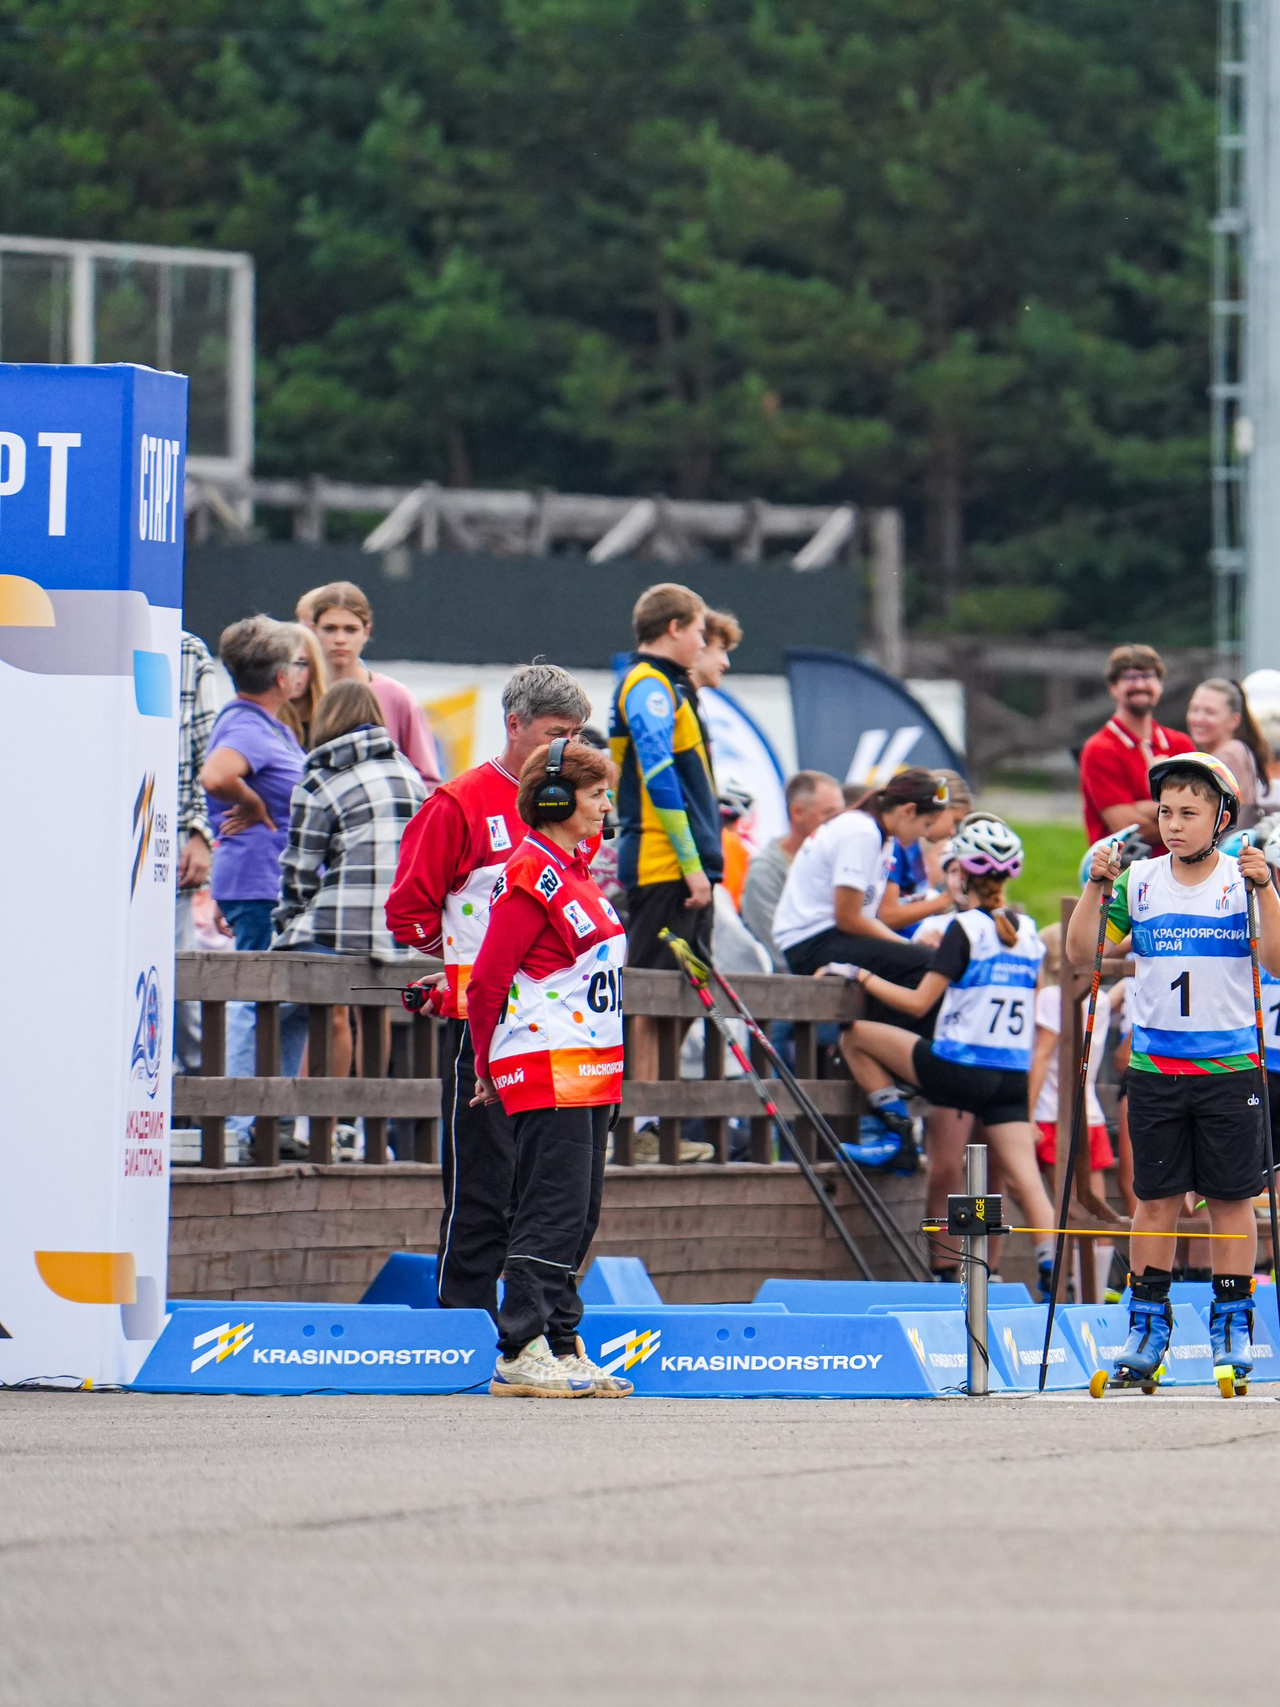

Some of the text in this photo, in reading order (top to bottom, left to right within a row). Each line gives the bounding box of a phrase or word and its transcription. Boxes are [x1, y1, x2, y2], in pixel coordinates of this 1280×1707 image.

[139, 433, 180, 543] СТАРТ
[1153, 927, 1245, 940] КРАСНОЯРСКИЙ
[1170, 971, 1190, 1017] 1
[989, 998, 1024, 1036] 75
[975, 1198, 985, 1221] ALGE
[1220, 1279, 1235, 1287] 151
[252, 1347, 476, 1366] KRASINDORSTROY
[661, 1353, 883, 1372] KRASINDORSTROY
